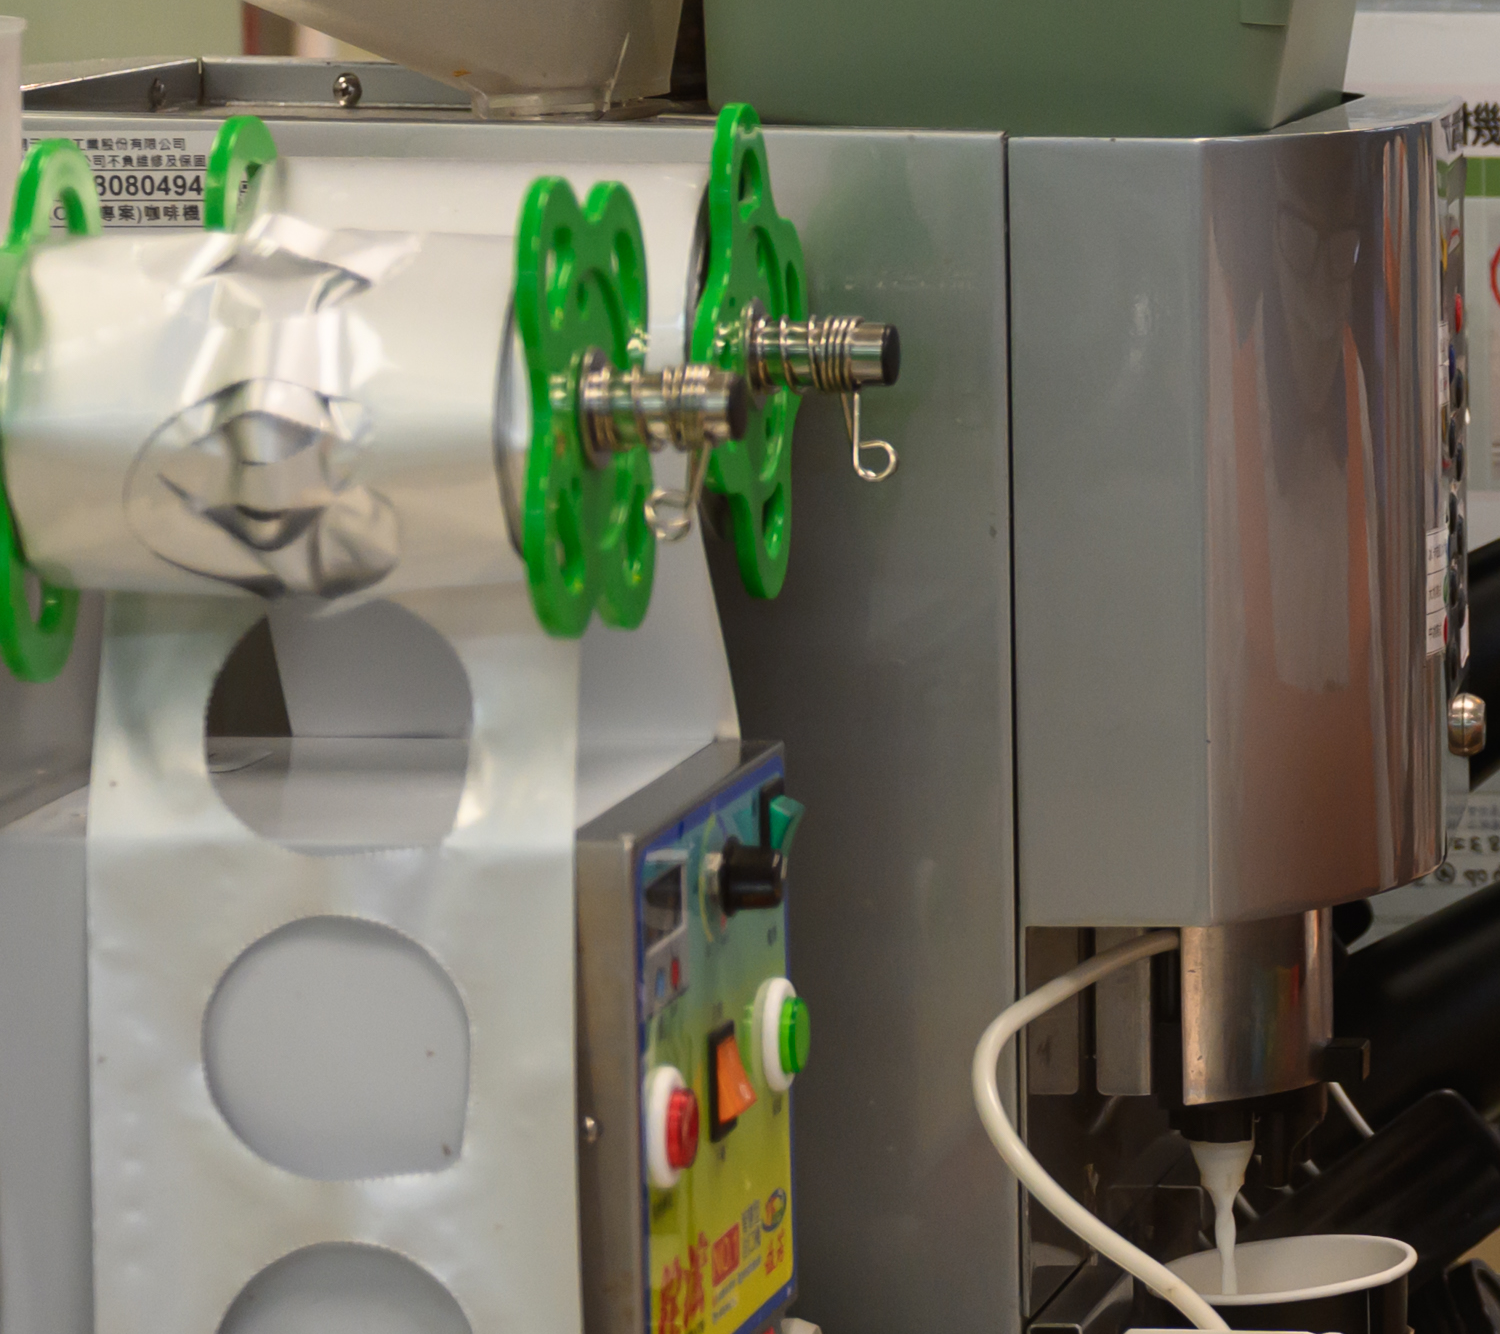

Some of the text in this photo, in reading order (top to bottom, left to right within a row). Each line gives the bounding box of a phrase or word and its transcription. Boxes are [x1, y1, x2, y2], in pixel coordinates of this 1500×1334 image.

[87, 155, 206, 168] 司不負維修及保固
